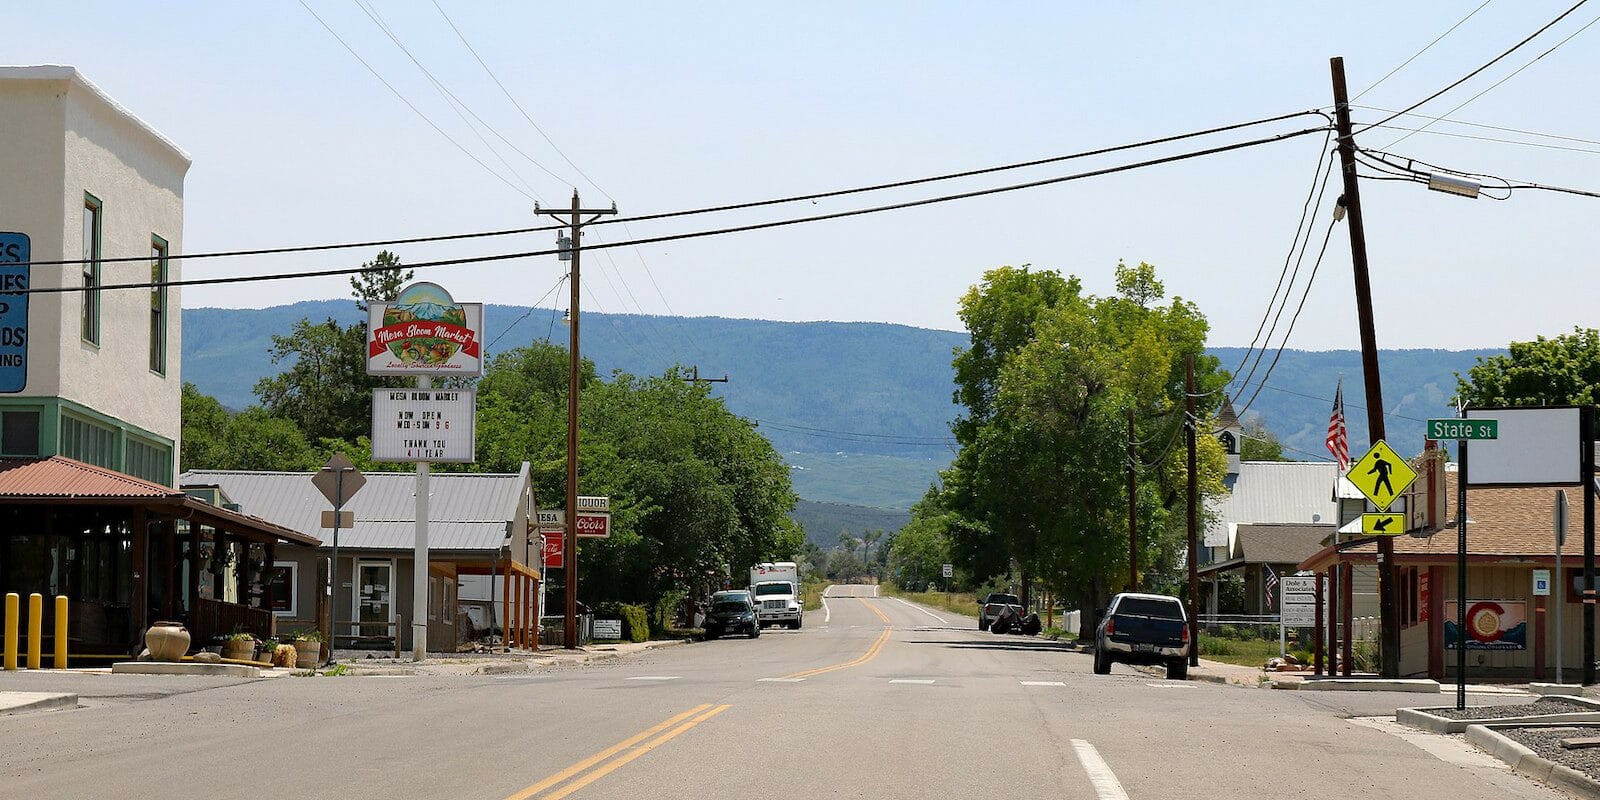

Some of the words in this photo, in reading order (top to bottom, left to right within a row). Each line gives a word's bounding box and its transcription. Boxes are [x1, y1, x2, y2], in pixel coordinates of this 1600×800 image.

[0, 243, 21, 264] S
[378, 328, 403, 343] Mesa
[406, 324, 431, 338] Bloom
[434, 325, 472, 343] Market
[389, 392, 407, 401] MESA
[435, 392, 458, 401] MARKET
[398, 411, 414, 420] NOW
[422, 411, 441, 420] OPEN
[1434, 422, 1473, 437] State
[1479, 425, 1492, 438] St
[403, 439, 428, 448] THANK
[433, 439, 446, 448] YOU
[578, 498, 606, 508] IQUOR
[577, 517, 604, 530] Coors
